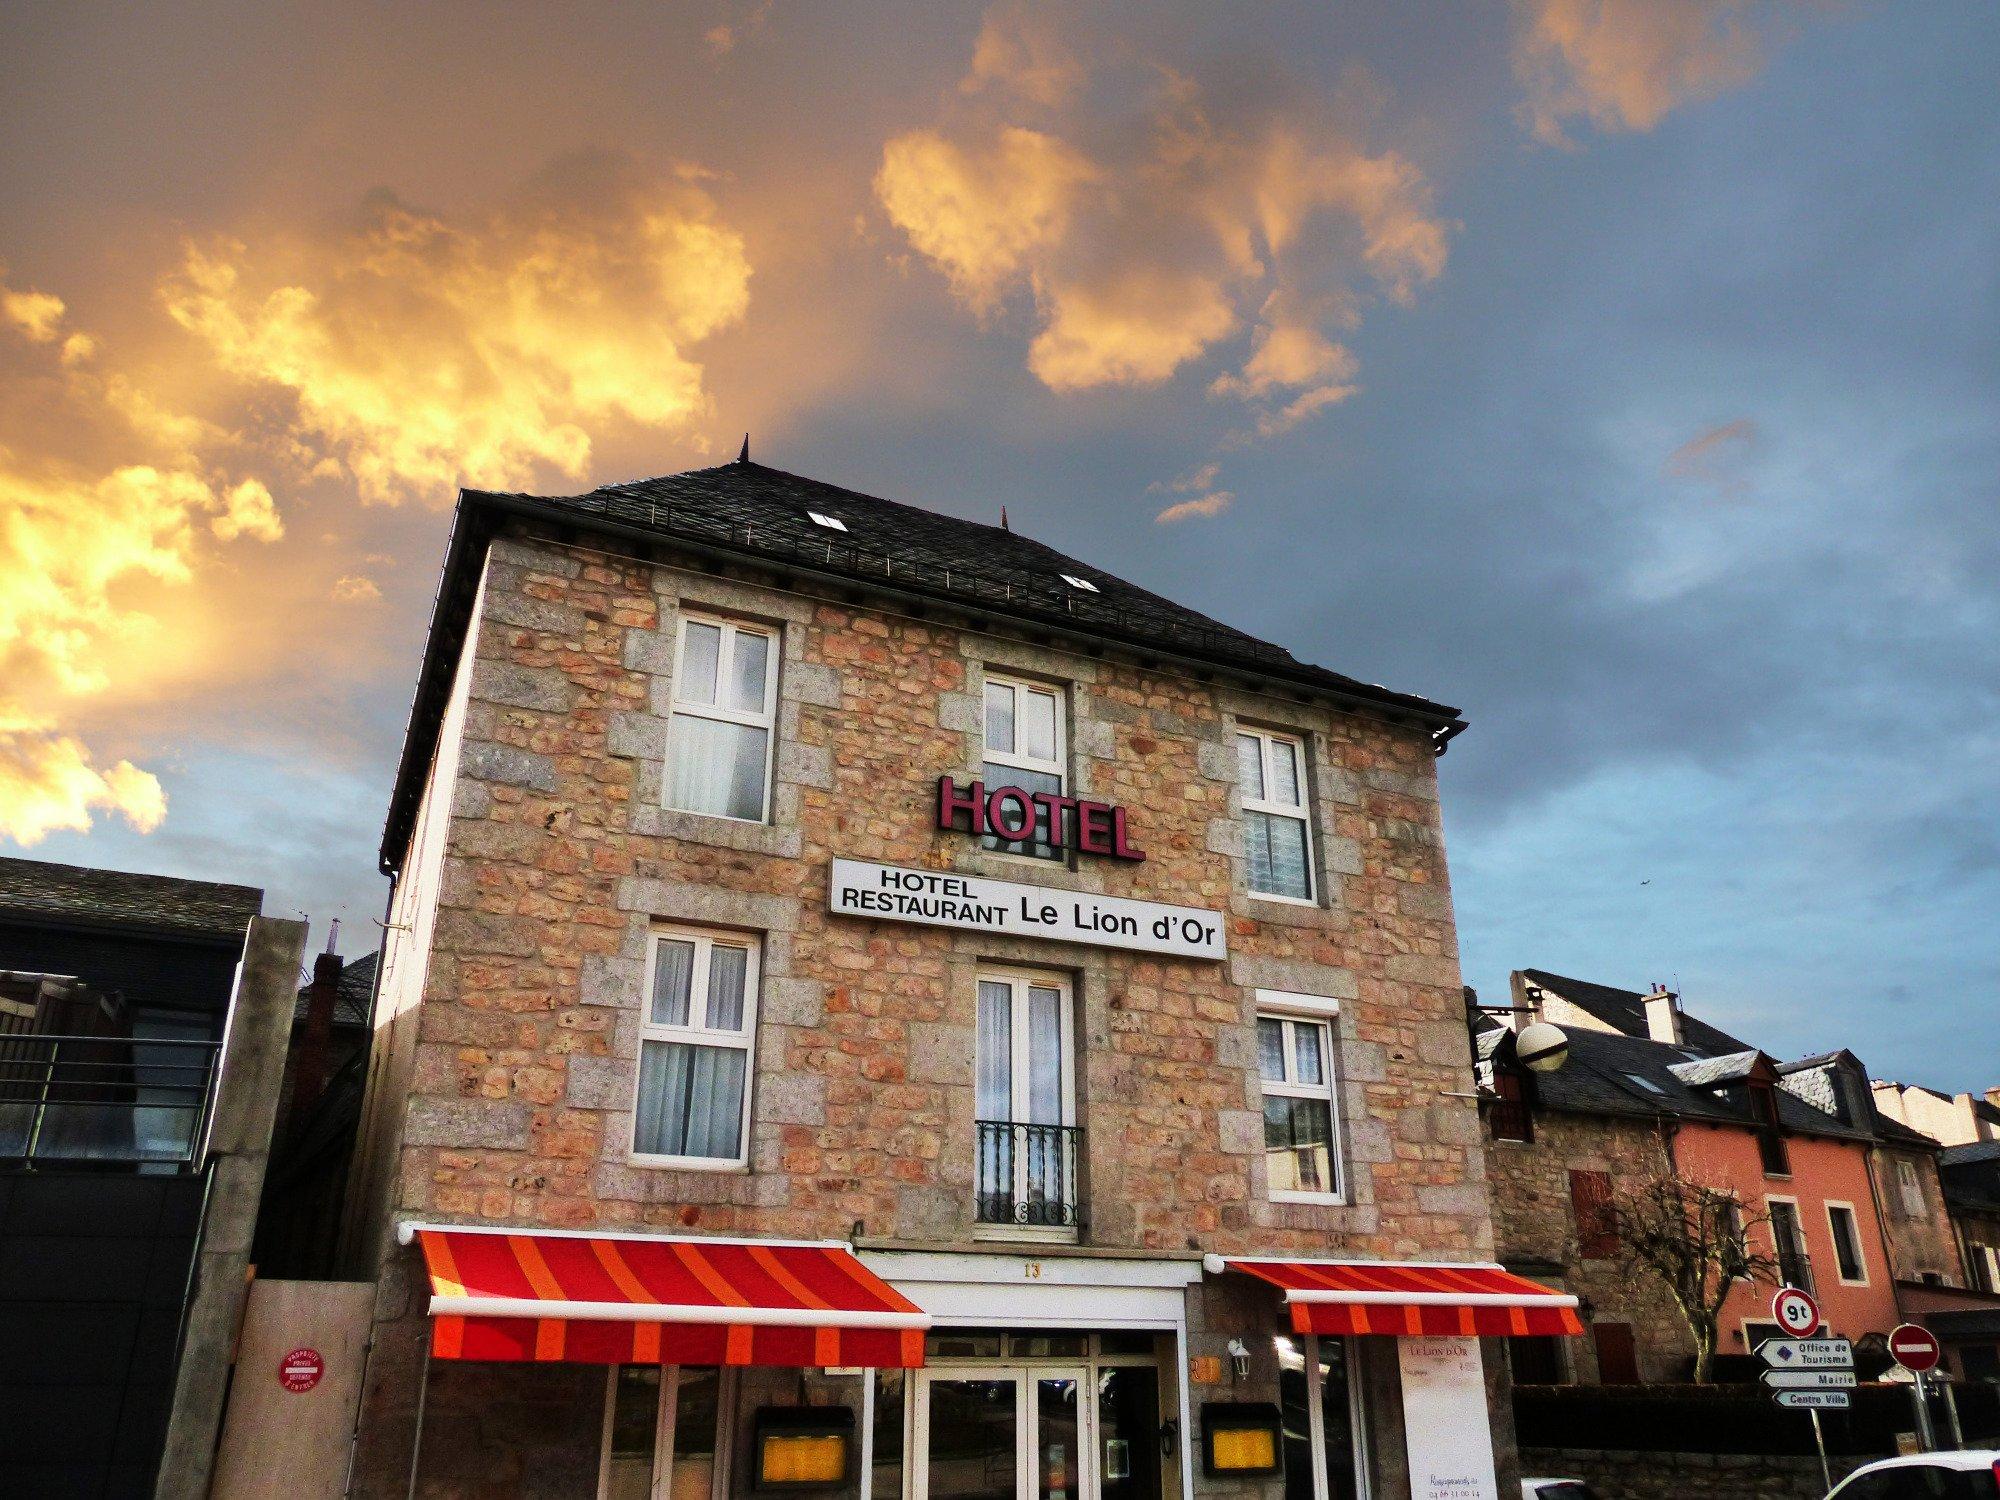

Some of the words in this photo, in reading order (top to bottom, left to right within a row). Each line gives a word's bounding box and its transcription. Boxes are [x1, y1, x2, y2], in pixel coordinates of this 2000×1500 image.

[938, 775, 1146, 862] HOTEL
[881, 869, 978, 899] HOTEL
[842, 887, 1009, 925] RESTAURANT
[1021, 896, 1058, 925] Le
[1074, 903, 1138, 936] Lion
[1152, 916, 1216, 946] d'Or
[1025, 1262, 1041, 1279] 13
[1799, 1343, 1830, 1353] Office
[1835, 1343, 1847, 1353] de
[1801, 1354, 1847, 1364] Tourisme
[1818, 1375, 1853, 1385] Mairie
[1790, 1394, 1821, 1404] Centre
[1825, 1394, 1846, 1404] Ville
